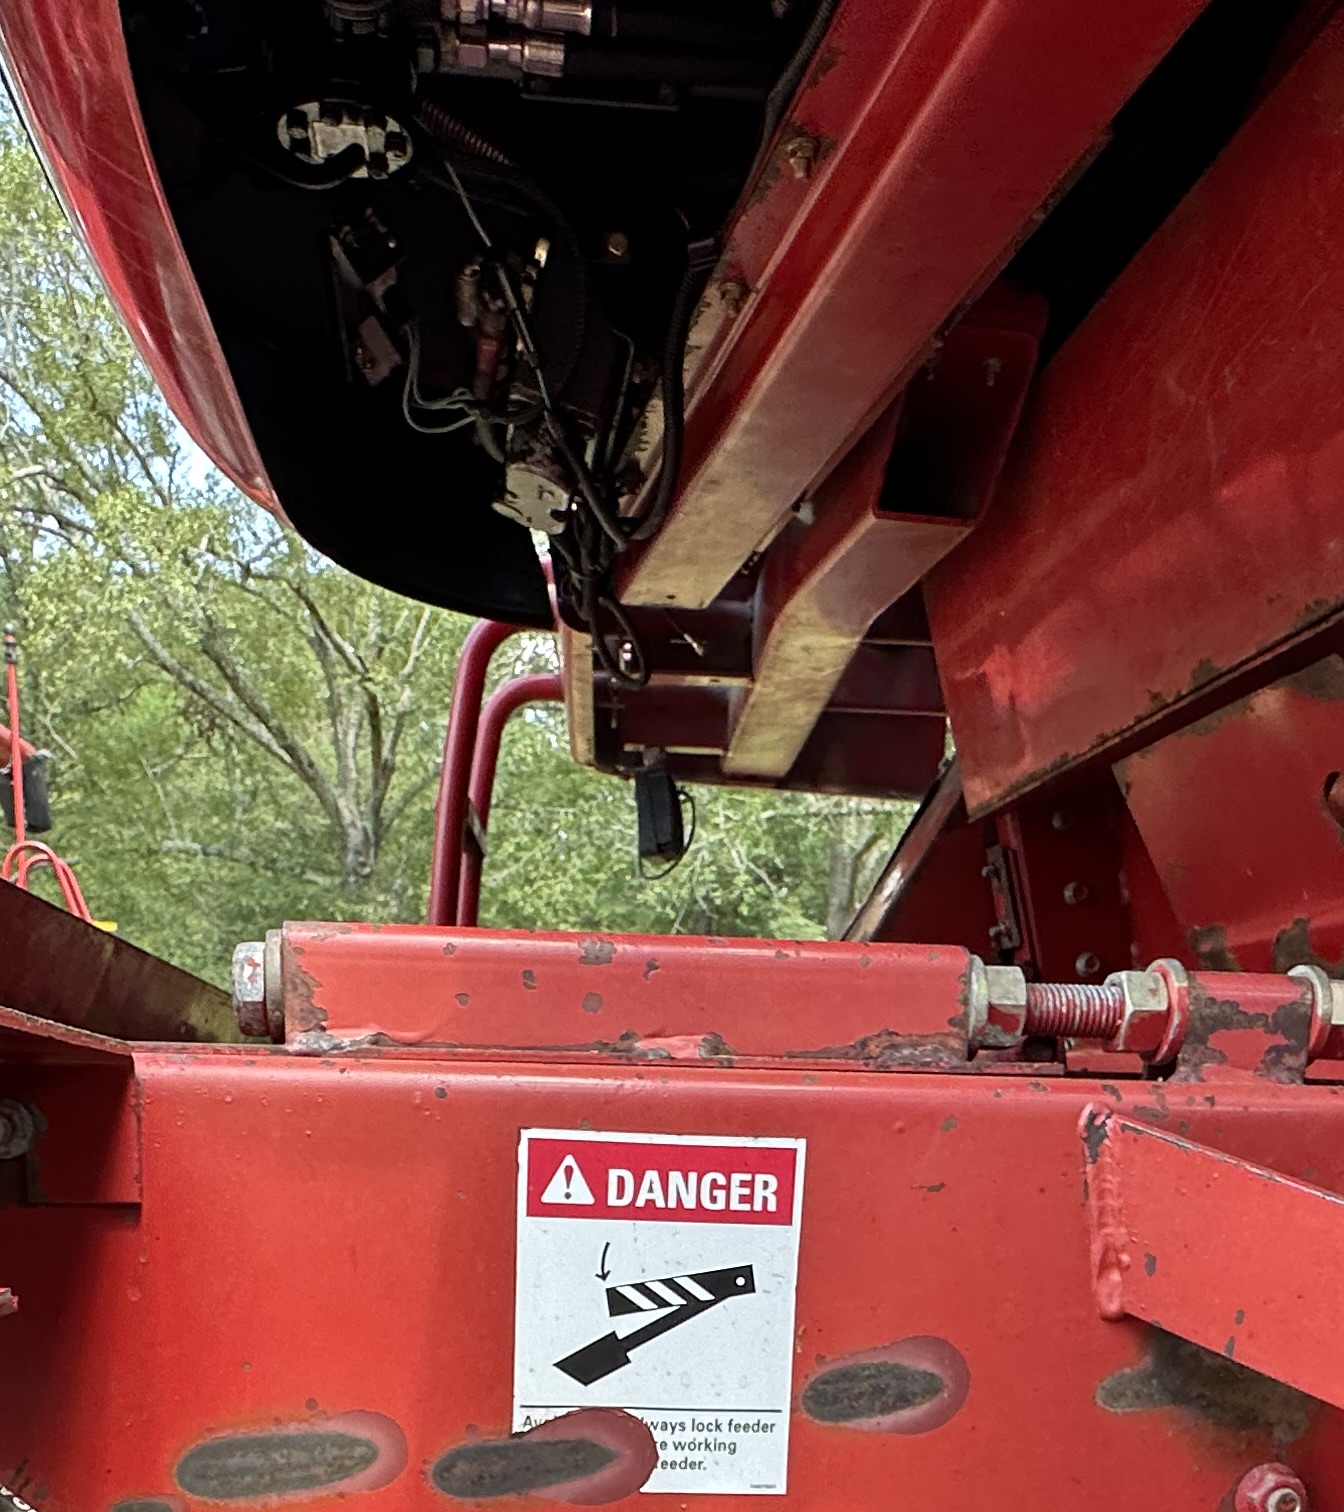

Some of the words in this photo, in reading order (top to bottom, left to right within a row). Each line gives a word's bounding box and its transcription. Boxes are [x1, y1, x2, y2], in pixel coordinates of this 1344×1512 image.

[607, 1168, 777, 1213] DANGER
[641, 1416, 686, 1436] ways
[691, 1417, 723, 1433] lock
[727, 1418, 776, 1434] feeder
[672, 1437, 737, 1455] working
[656, 1456, 707, 1471] eeder.
